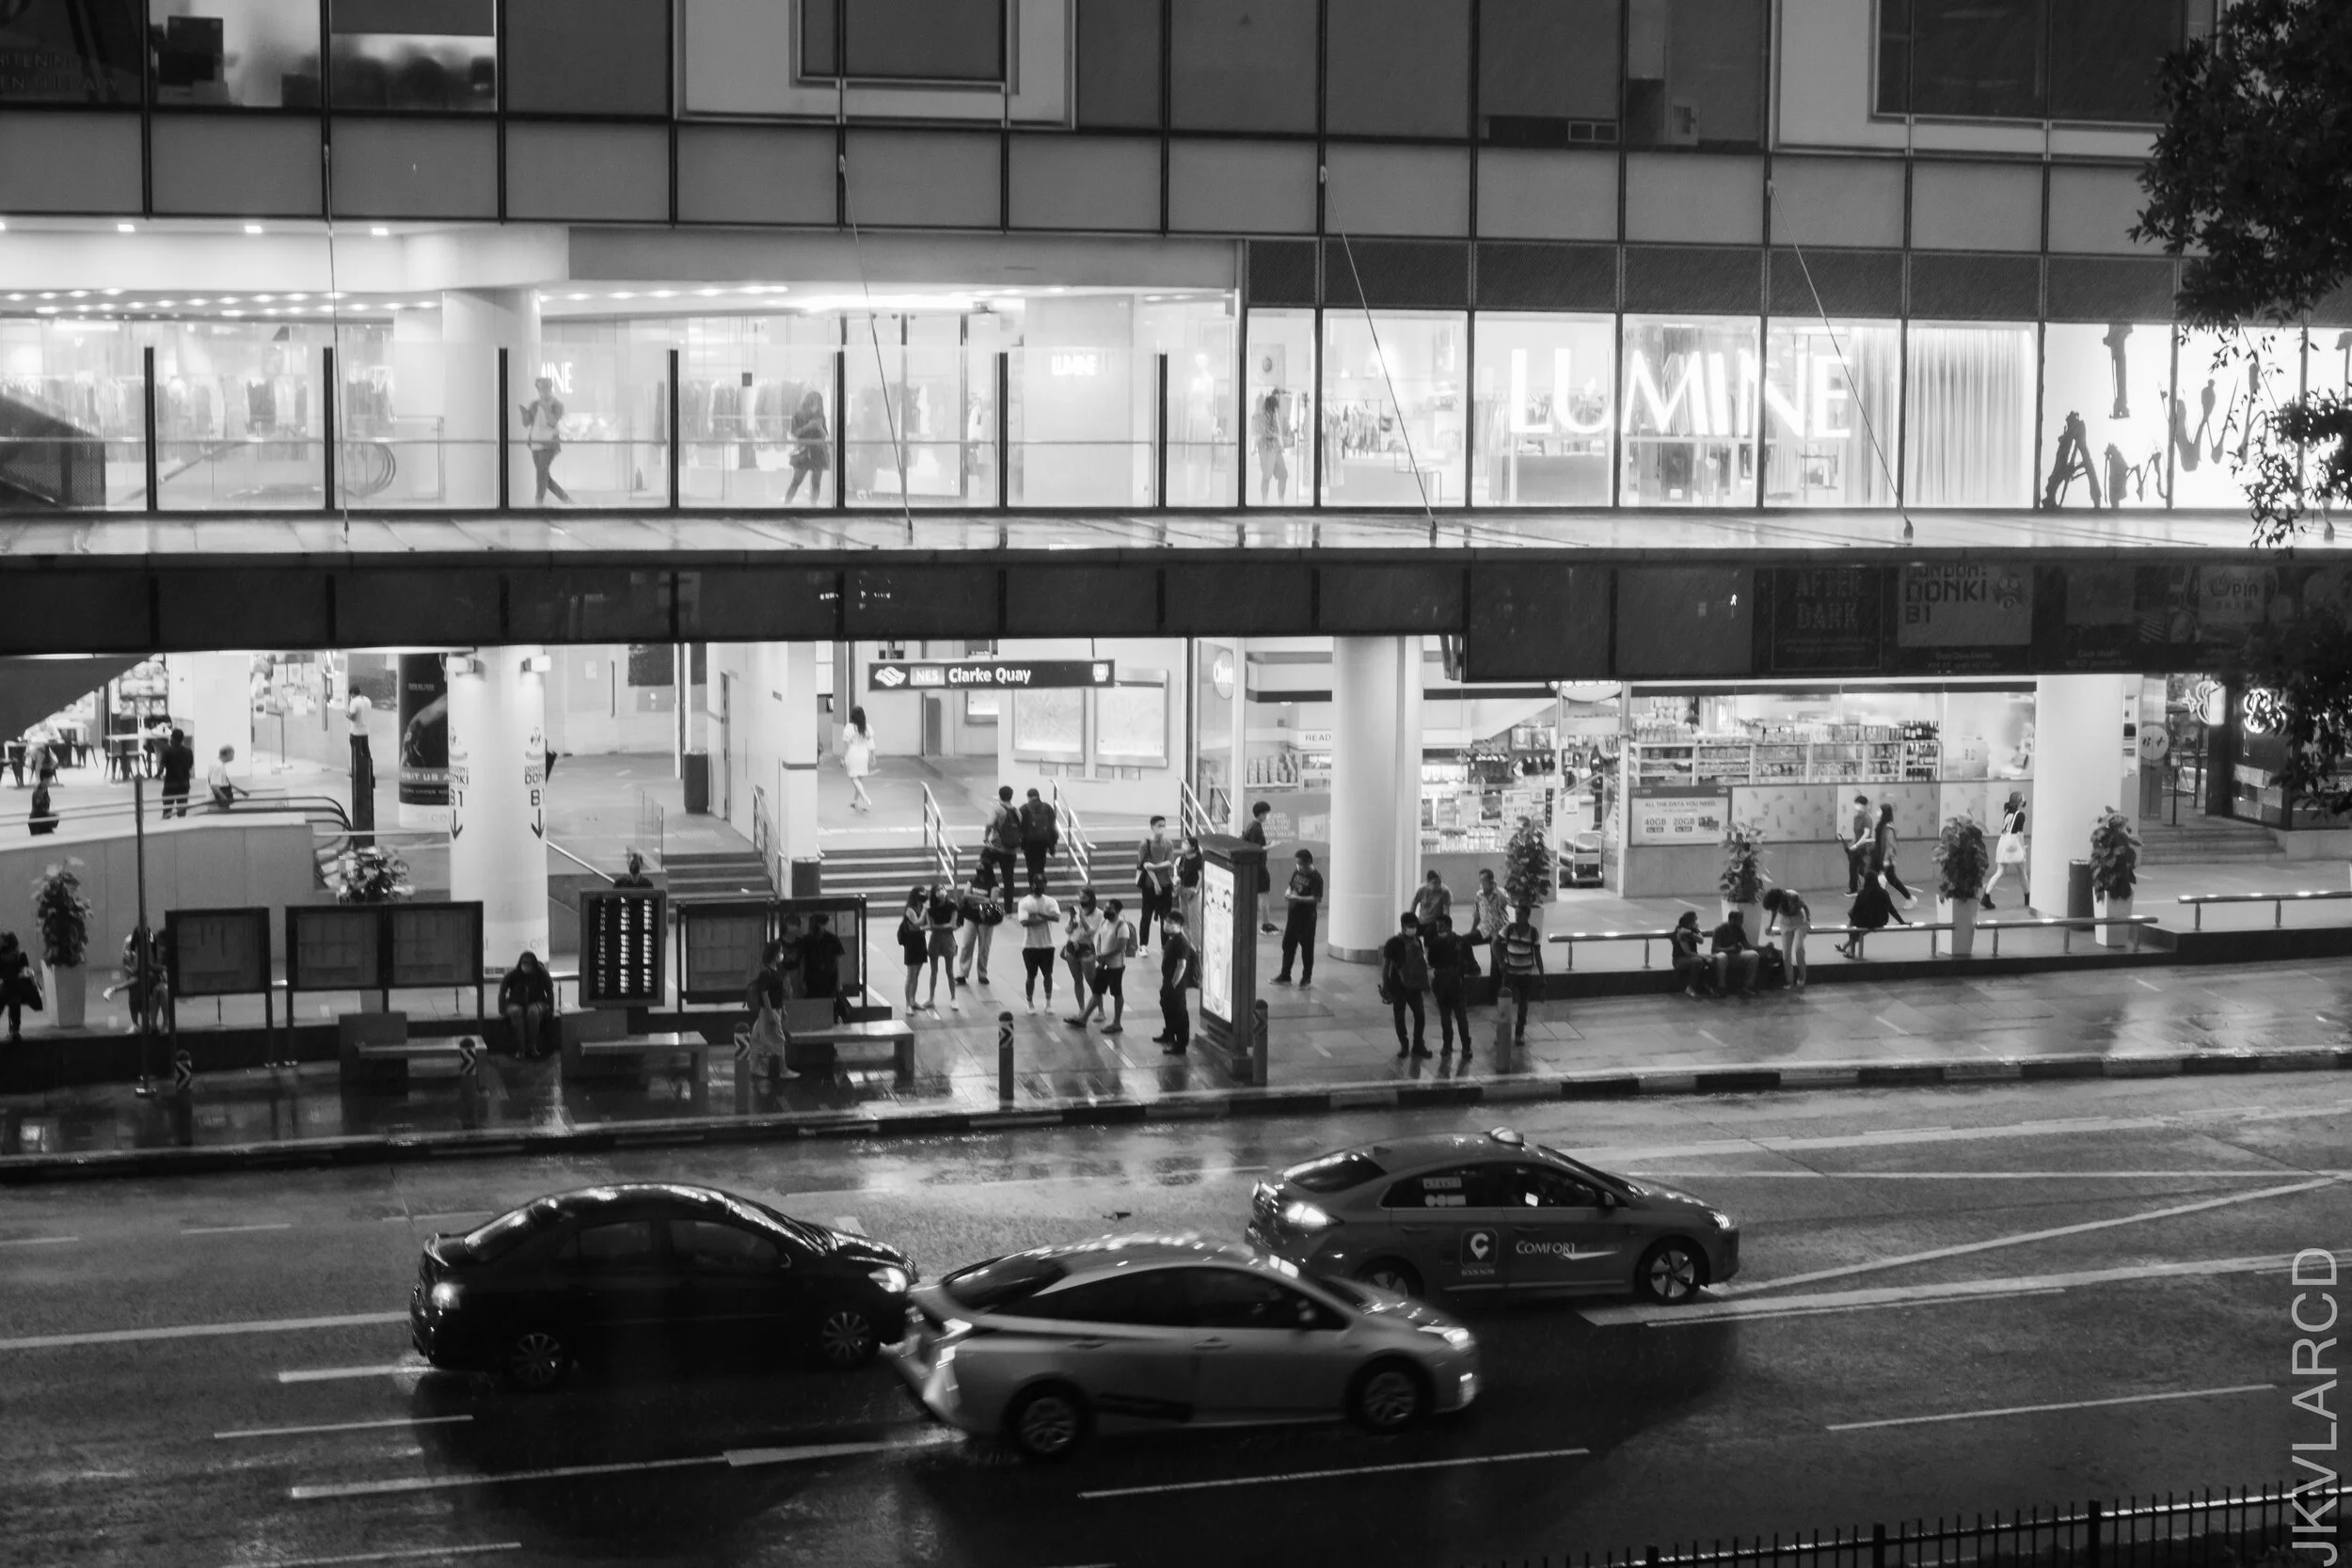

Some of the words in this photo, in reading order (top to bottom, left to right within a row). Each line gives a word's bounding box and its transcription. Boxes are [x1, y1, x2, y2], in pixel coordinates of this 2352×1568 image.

[1510, 348, 1851, 438] LUMINE
[1906, 578, 1986, 602] DONKI
[916, 669, 939, 682] NE5
[948, 668, 992, 683] Clarke
[995, 668, 1031, 685] Quay
[1305, 733, 1331, 742] READ
[1645, 817, 1666, 826] 40GB
[1516, 1240, 1575, 1255] COMFORT
